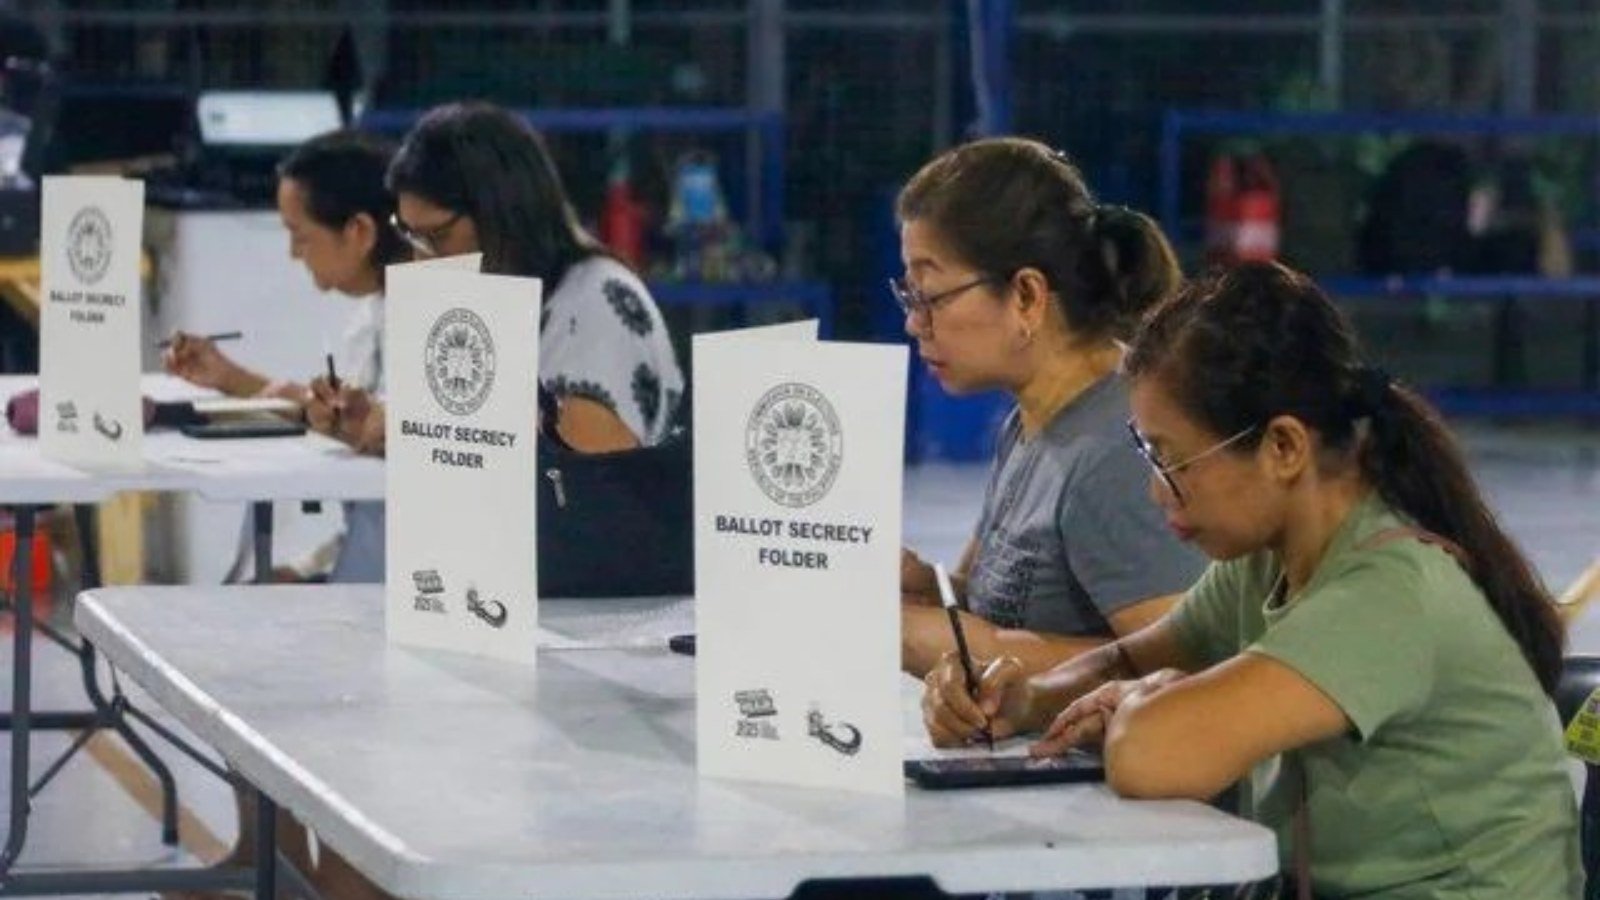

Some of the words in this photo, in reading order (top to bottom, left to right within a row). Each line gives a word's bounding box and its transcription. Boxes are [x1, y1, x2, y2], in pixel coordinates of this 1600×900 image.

[401, 420, 451, 439] BALLOT
[454, 426, 516, 448] SECRECY
[431, 448, 484, 469] FOLDER
[716, 515, 783, 536] BALLOT
[789, 520, 873, 543] SECRECY
[759, 548, 828, 569] FOLDER
